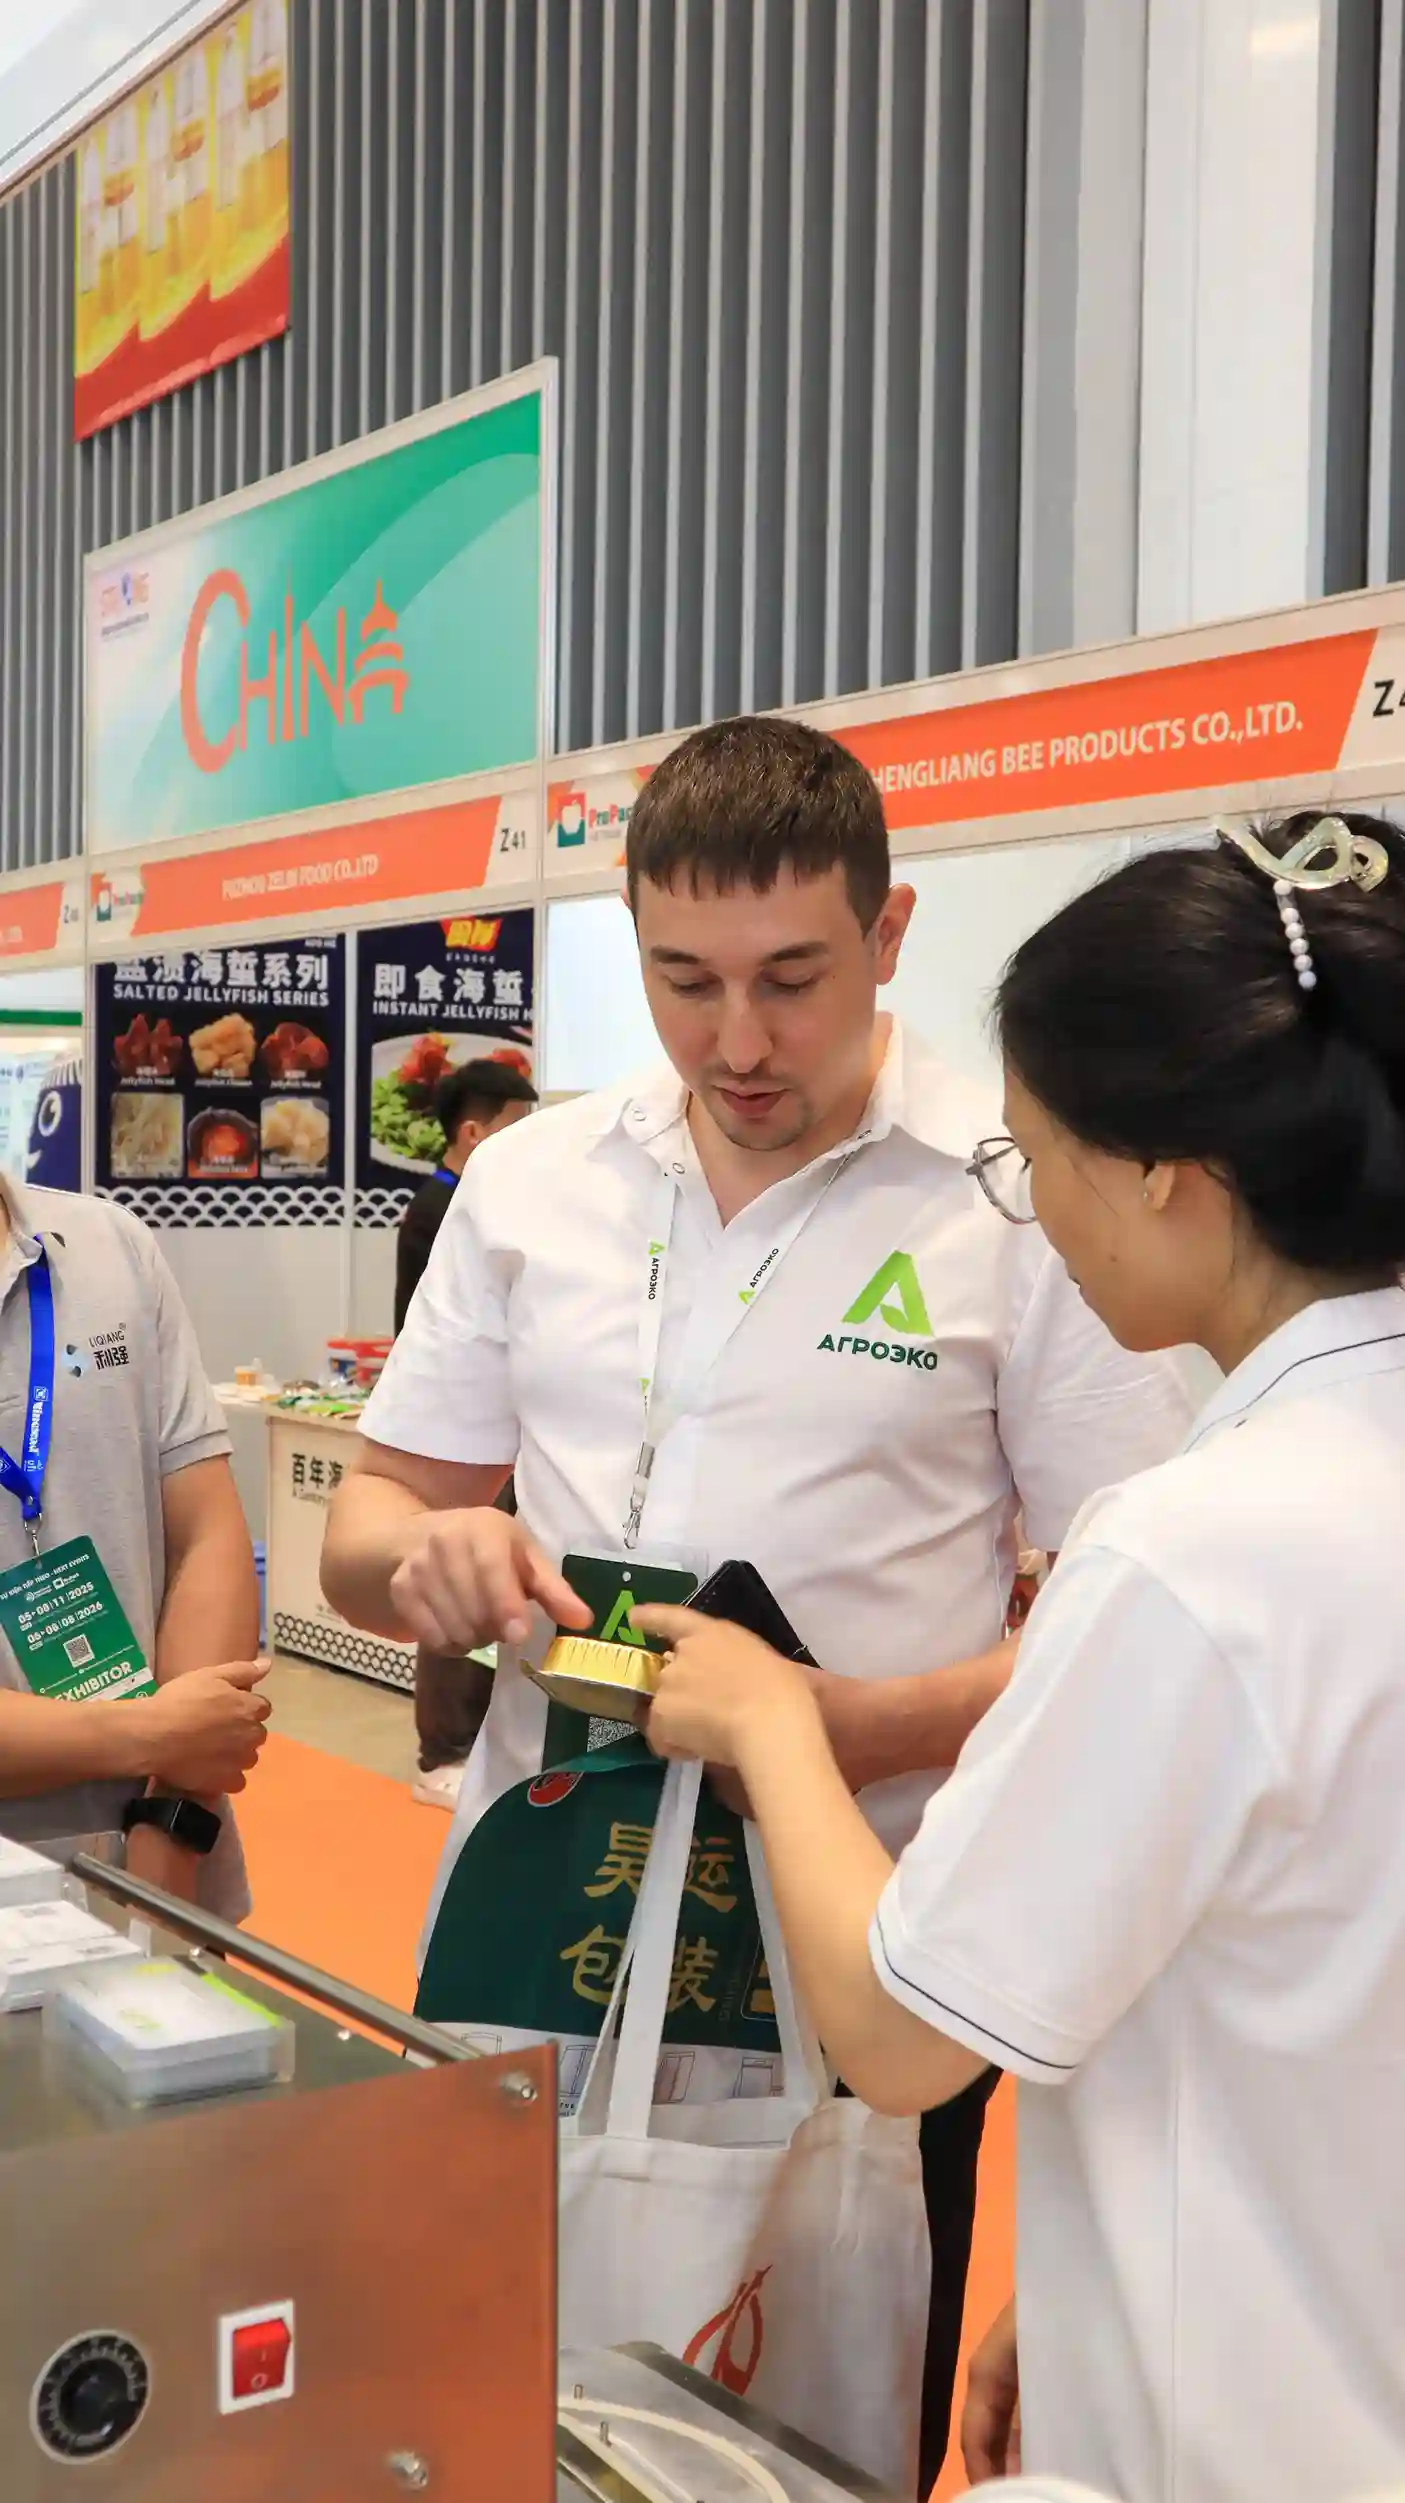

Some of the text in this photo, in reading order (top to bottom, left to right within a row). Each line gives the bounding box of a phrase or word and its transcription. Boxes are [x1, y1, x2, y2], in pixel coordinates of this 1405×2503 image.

[181, 566, 409, 774] CHINA
[1002, 741, 1044, 776] BEE
[1049, 718, 1186, 768] PRODUCTS
[1192, 701, 1303, 745] CO.,LTD.
[500, 828, 526, 852] Z41
[113, 984, 329, 1007] SALTED JELLYFISH SERIES
[372, 1001, 439, 1017] INSTANT
[442, 1004, 520, 1021] JELLYFISH
[648, 1257, 660, 1301] АГРОЭКО
[749, 1247, 779, 1289] АГРОЭКО
[88, 1330, 125, 1348] LIQIANG
[93, 1345, 130, 1371] 利强
[817, 1333, 939, 1371] АГРОЭКО
[55, 1660, 133, 1701] EXHIBITOR
